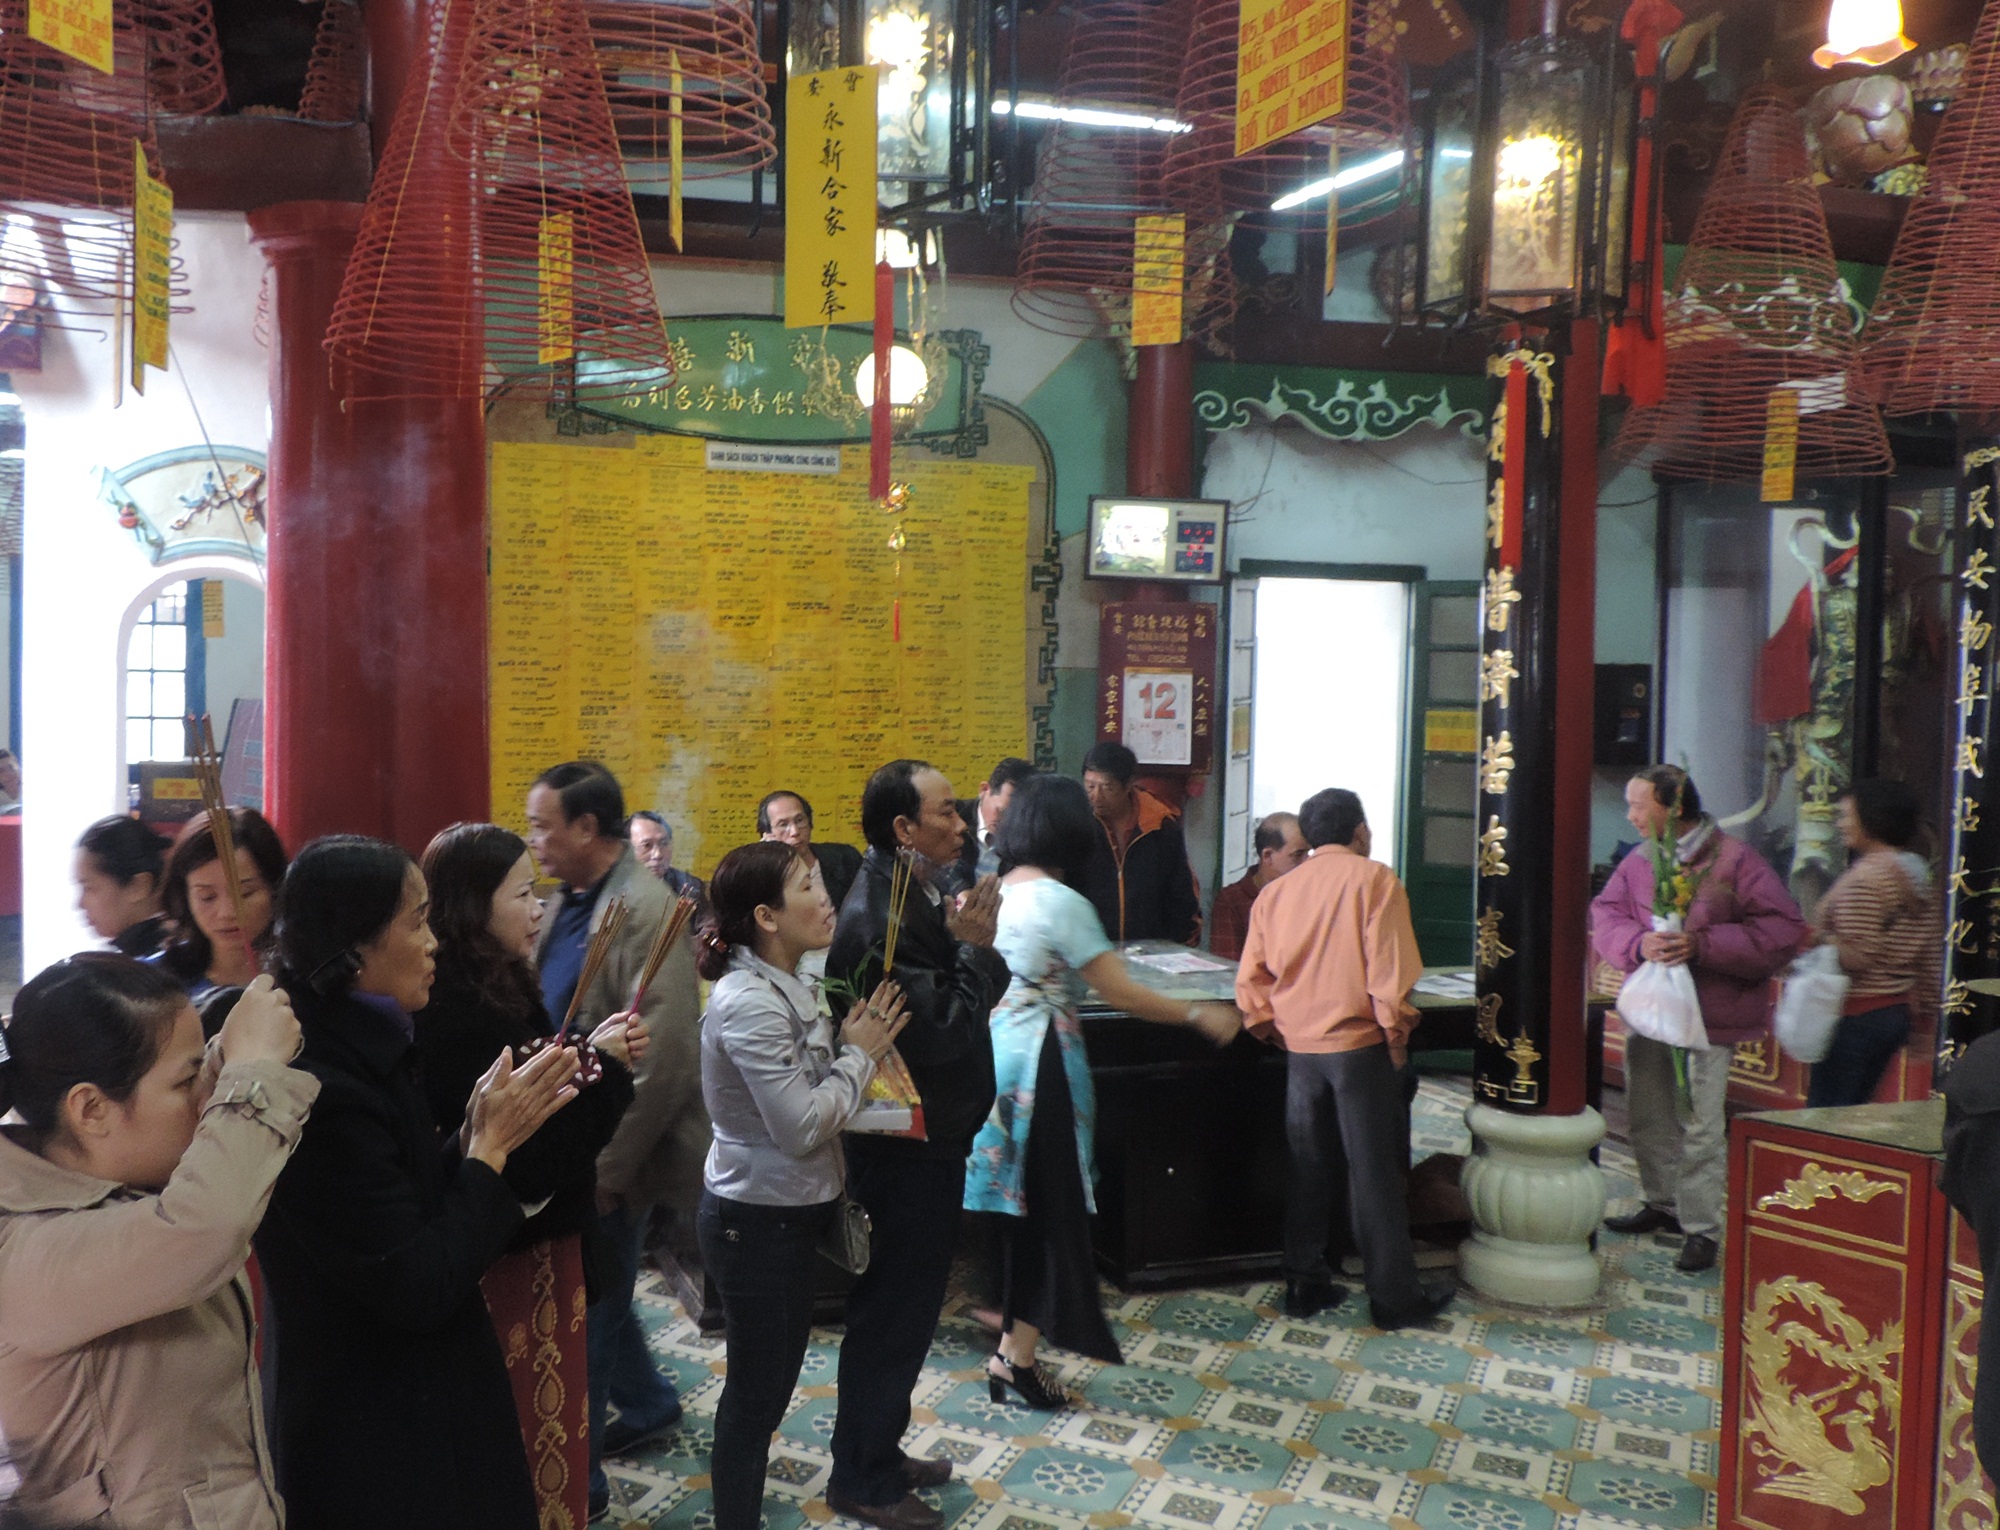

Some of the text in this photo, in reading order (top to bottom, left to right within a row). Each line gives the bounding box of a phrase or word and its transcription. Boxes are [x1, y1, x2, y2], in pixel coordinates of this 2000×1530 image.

[1103, 673, 1120, 734] 家家平安
[1138, 681, 1177, 720] 12
